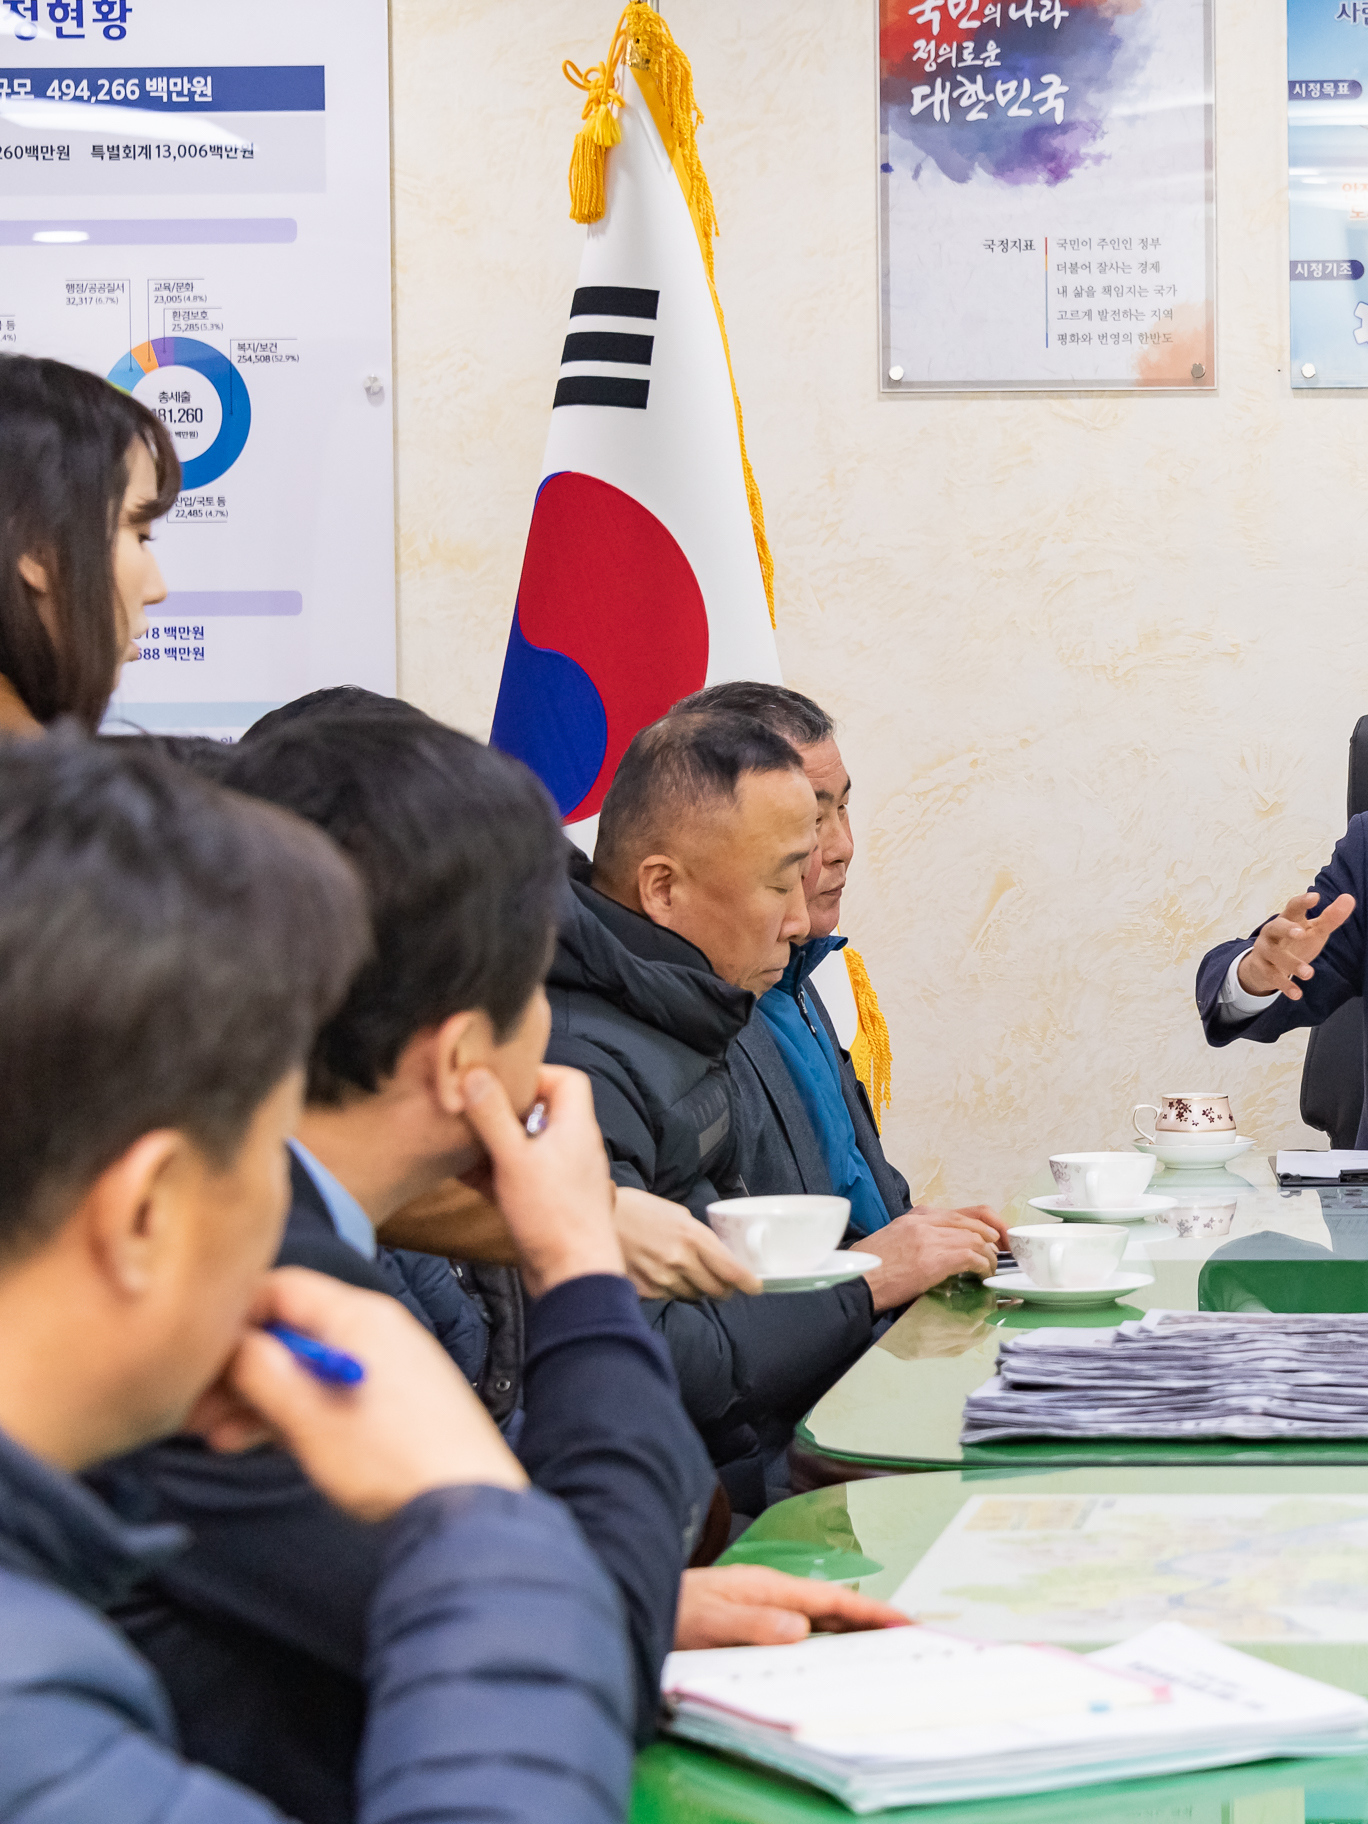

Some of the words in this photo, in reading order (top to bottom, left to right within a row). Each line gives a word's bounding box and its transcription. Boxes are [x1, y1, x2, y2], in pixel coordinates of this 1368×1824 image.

[912, 38, 1001, 72] 정의로운
[46, 78, 140, 103] 494,266
[145, 76, 213, 102] 백만원
[1293, 82, 1350, 97] 시정목표
[910, 73, 1070, 125] 대한민국
[983, 238, 1036, 253] 국정지표
[1056, 237, 1092, 251] 국민이
[1096, 237, 1133, 250] 주인인
[1137, 237, 1161, 250] 정부
[1056, 261, 1092, 275] 더불어
[1096, 261, 1133, 275] 잘사는
[1137, 261, 1160, 274] 경제
[1295, 262, 1352, 277] 시정기조
[153, 282, 194, 293] 교육/문화
[1056, 285, 1068, 298] 내
[1072, 285, 1097, 298] 삶을
[1101, 285, 1150, 298] 책임지는
[1153, 284, 1178, 297] 국가
[172, 311, 209, 321] 환경보호
[1057, 308, 1093, 322] 고르게
[1097, 308, 1146, 322] 발전하는
[1150, 308, 1174, 321] 지역
[1057, 332, 1093, 346] 평화와
[1097, 332, 1133, 345] 번영의
[1137, 332, 1174, 346] 한반도
[237, 343, 278, 353] 복지/보건
[159, 391, 191, 404] 총세출
[164, 626, 204, 640] 백만원
[164, 647, 204, 661] 백만원
